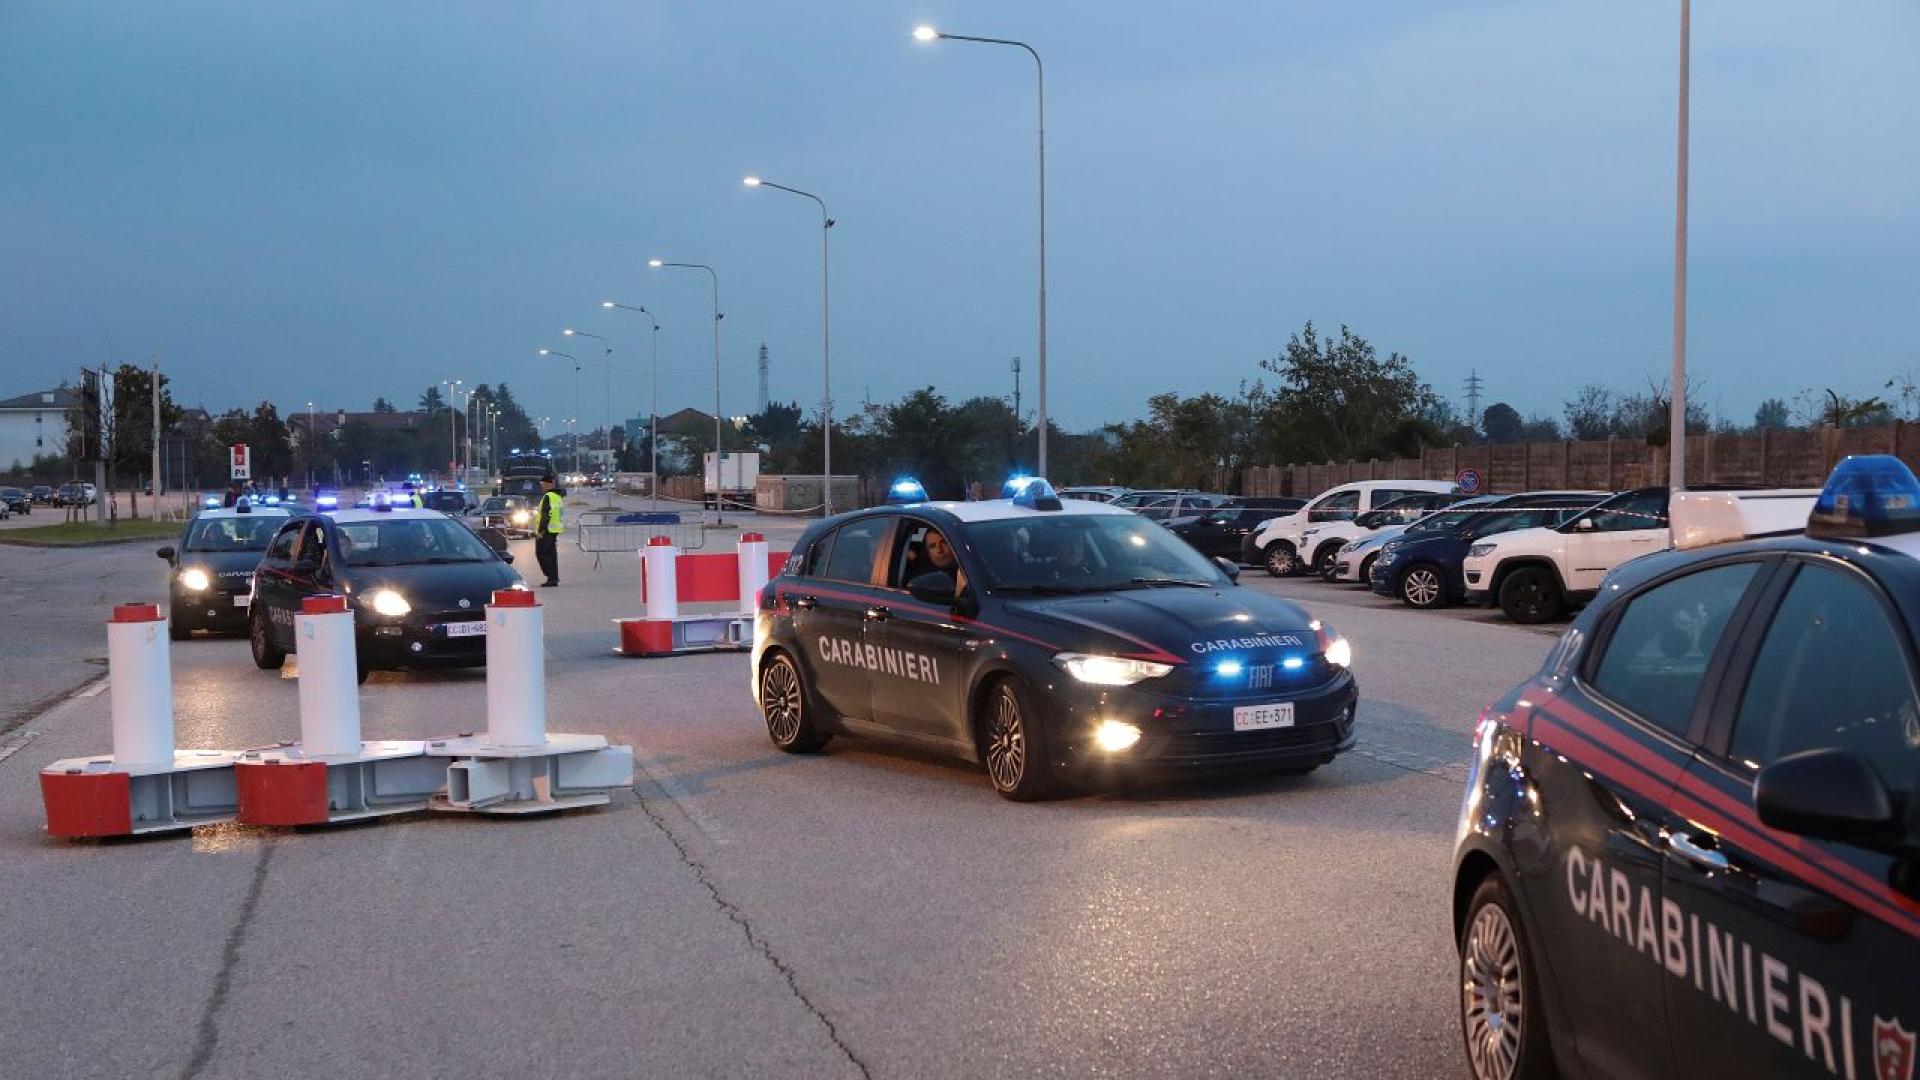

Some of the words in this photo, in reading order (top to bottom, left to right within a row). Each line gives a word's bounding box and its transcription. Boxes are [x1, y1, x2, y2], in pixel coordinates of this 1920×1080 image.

[235, 468, 246, 477] P4
[1190, 635, 1304, 653] CARABINIERI
[818, 635, 940, 685] CARABINIERI
[1248, 664, 1274, 689] FIAT
[1566, 845, 1856, 1080] CARABINIERI
